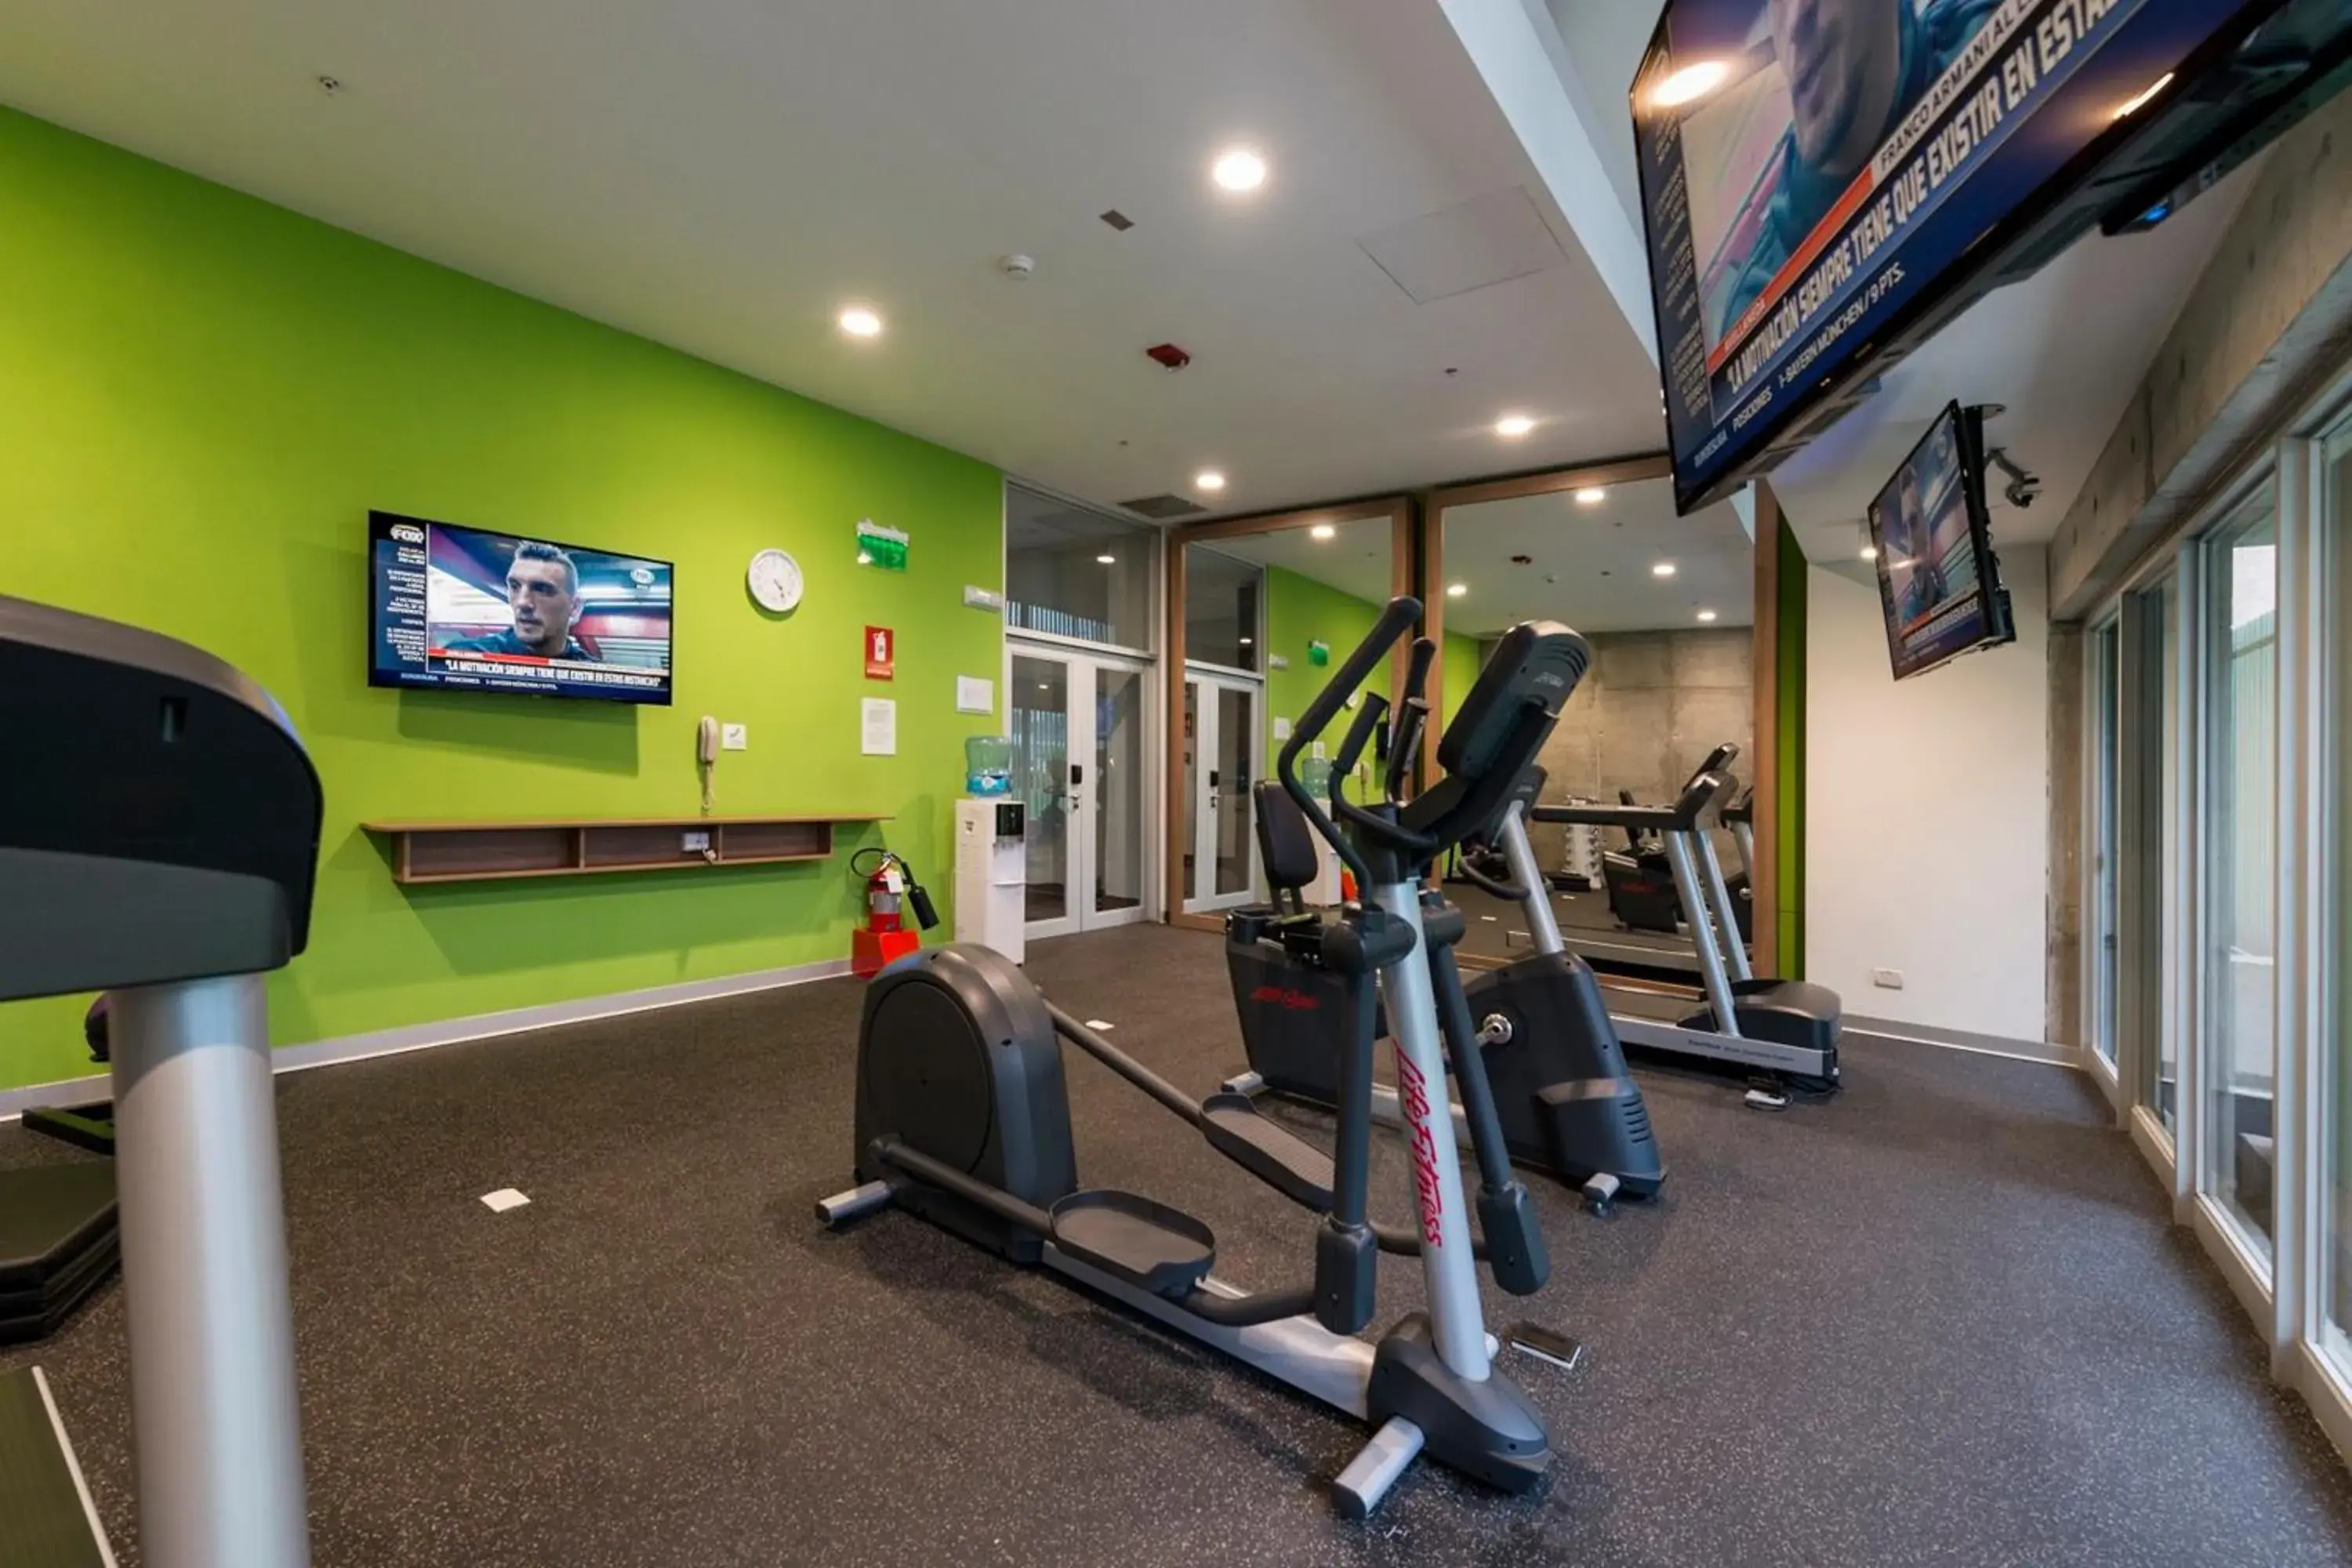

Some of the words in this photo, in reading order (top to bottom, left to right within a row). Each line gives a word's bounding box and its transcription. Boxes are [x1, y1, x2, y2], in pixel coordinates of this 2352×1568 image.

[1741, 296, 1798, 380] MOTIVACIÓN
[1798, 238, 1853, 322] SIEMPRE
[1850, 192, 1894, 267] TIENE
[1893, 154, 1929, 224] QUE
[1926, 75, 2004, 189] EXISTIR
[2002, 35, 2038, 111] EN
[1881, 103, 1930, 172] FRANCO
[1932, 31, 1991, 114] ARMANI
[1993, 9, 2014, 43] AL
